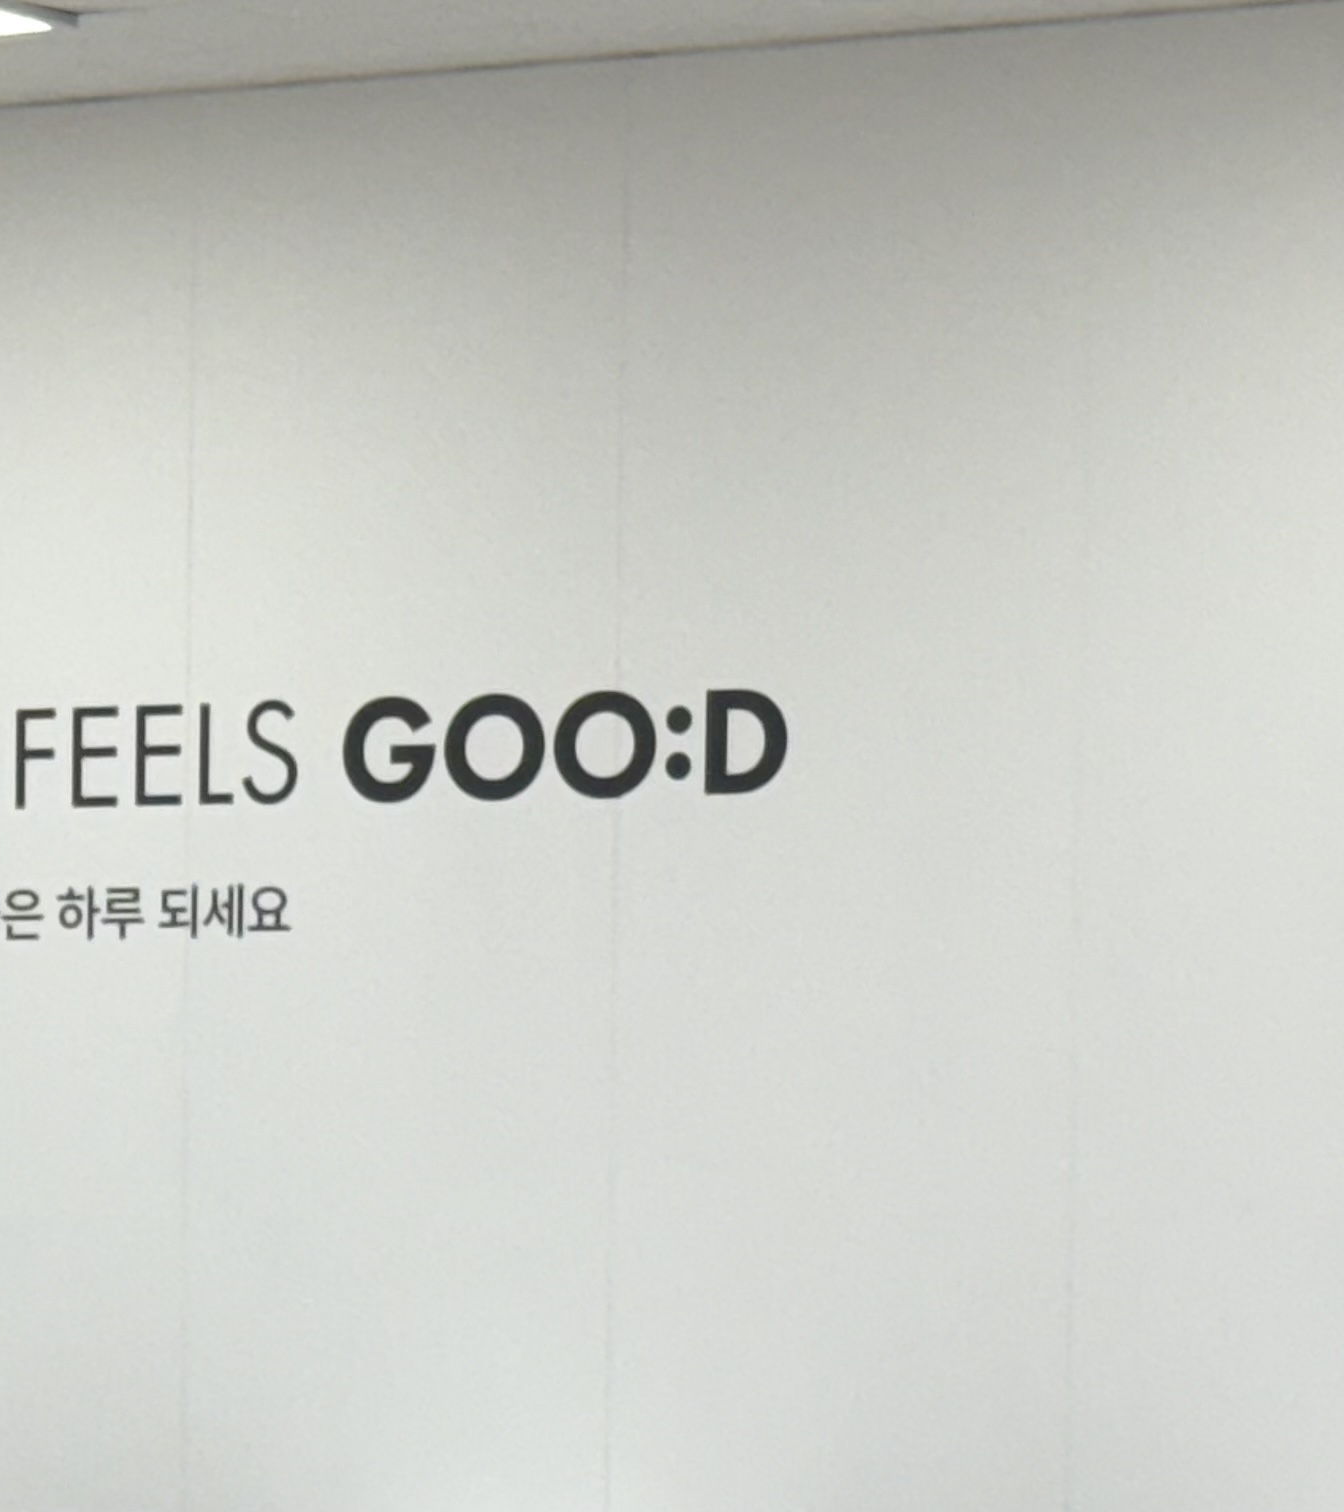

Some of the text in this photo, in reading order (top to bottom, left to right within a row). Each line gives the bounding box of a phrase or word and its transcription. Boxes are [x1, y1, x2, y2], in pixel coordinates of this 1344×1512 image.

[15, 699, 298, 810] FEELS
[342, 689, 788, 803] GOO:D
[56, 885, 145, 941] 하루
[158, 883, 292, 940] 되세요
